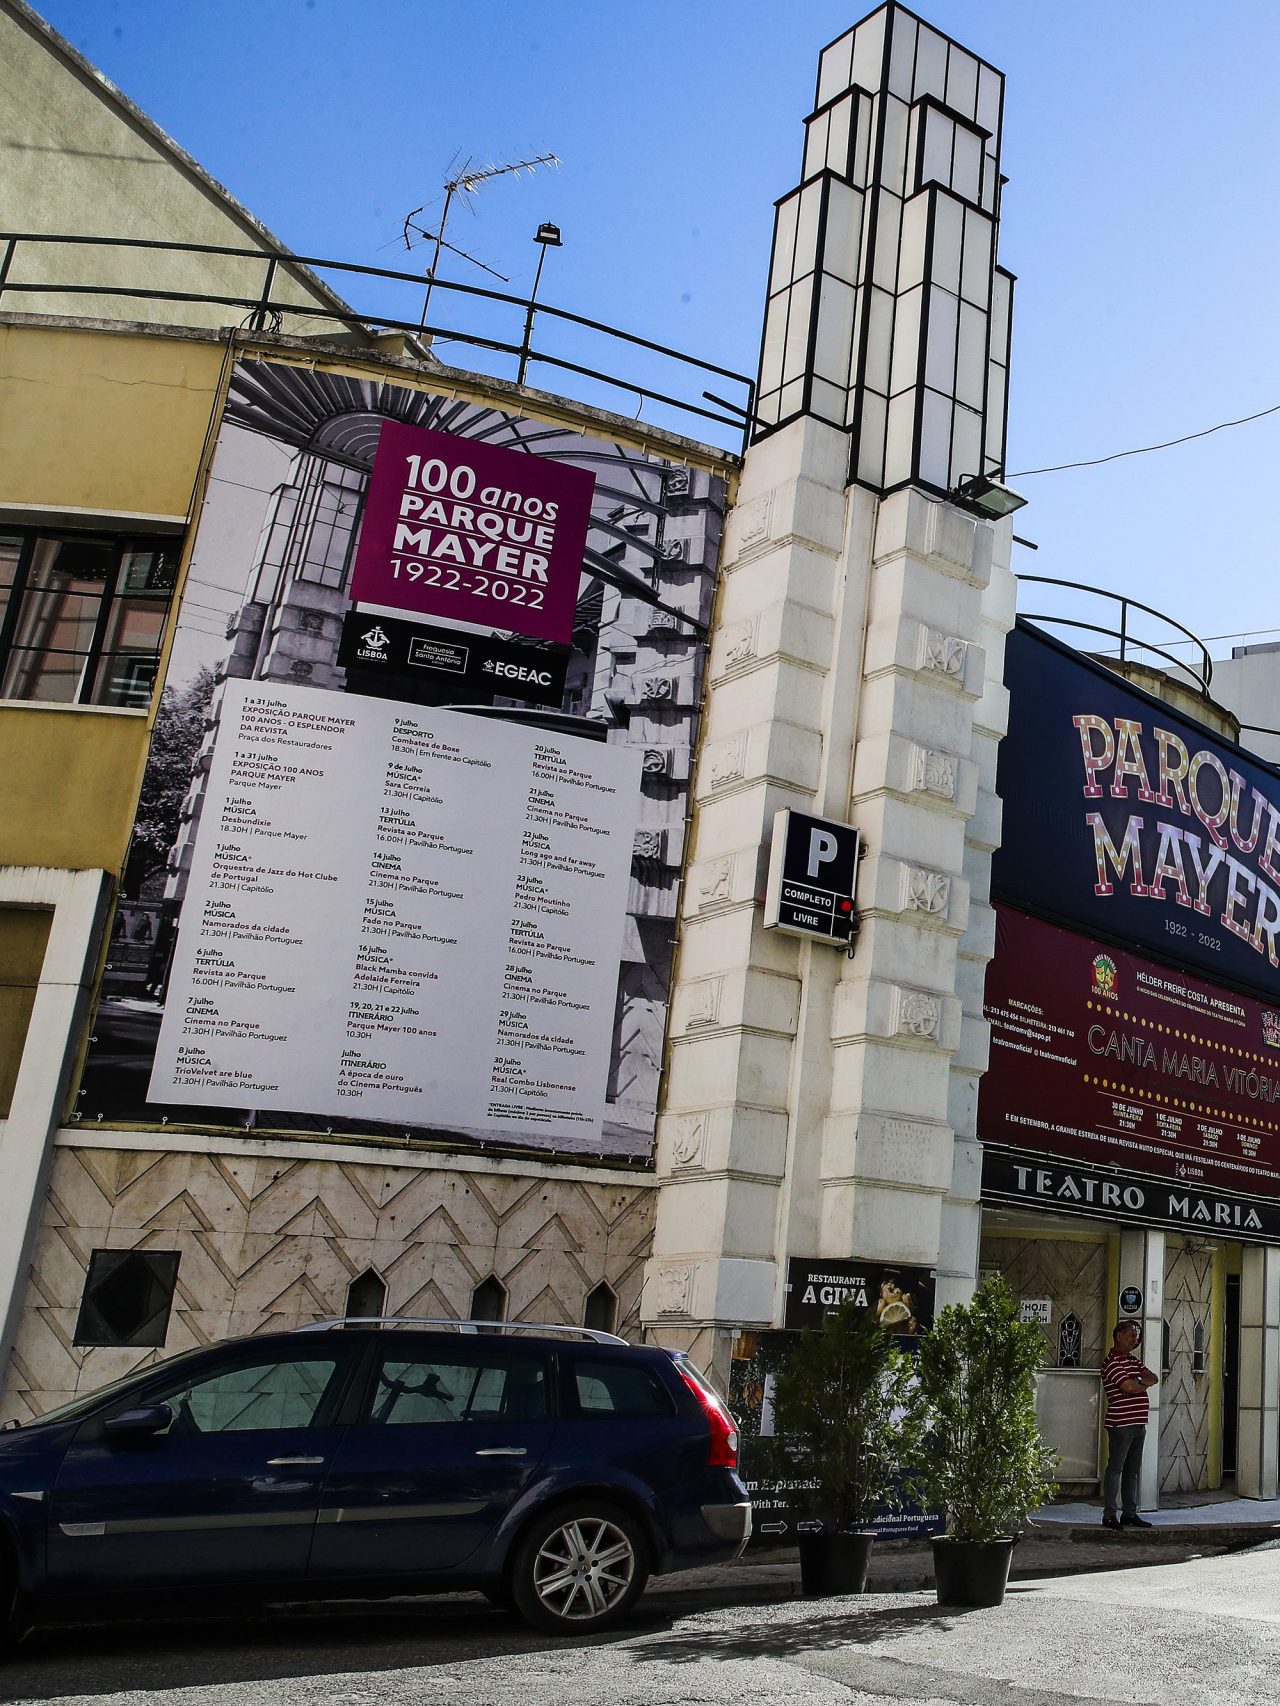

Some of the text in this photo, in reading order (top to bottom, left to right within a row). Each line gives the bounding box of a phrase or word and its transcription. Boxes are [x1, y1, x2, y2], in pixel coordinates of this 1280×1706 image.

[405, 454, 558, 521] 100 anos
[400, 494, 554, 550] PARQUE
[393, 524, 549, 583] MAYER
[390, 560, 544, 610] 1922-2022
[357, 649, 387, 660] LISBOA
[495, 662, 551, 686] EGEAC
[267, 700, 287, 708] julho
[242, 706, 355, 726] EXPOSIÇÃO PARQUE MAYER
[254, 726, 288, 735] REVISTA
[257, 717, 281, 725] ANOS
[297, 722, 345, 734] ESPLENDOR
[393, 727, 433, 739] DESPORTO
[239, 733, 259, 743] Praça
[278, 738, 332, 750] Restauradores
[392, 736, 429, 748] Combates
[442, 744, 459, 753] Boxe
[258, 754, 278, 762] julho
[231, 770, 296, 782] PARQUE MAYER
[233, 761, 281, 772] EXPOSIÇÃO
[300, 768, 324, 776] ANOS
[229, 779, 282, 791] Parque Mayer
[403, 783, 430, 793] Correia
[231, 798, 251, 806] julho
[223, 805, 257, 815] MÚSICA
[222, 816, 271, 827] Desbundixie
[521, 849, 596, 868] Long ago and far away
[807, 828, 838, 878] P
[213, 863, 338, 881] Orquestra de Jazz do Hot Clube
[223, 872, 258, 882] Portugal
[515, 893, 571, 908] Pedro Moutinho
[784, 888, 831, 906] COMPLETO
[202, 919, 249, 930] Namorados
[263, 925, 289, 933] cidade
[794, 912, 818, 926] LIVRE
[1164, 919, 1188, 938] 1922
[1198, 932, 1221, 951] 2022
[356, 964, 438, 979] Black Mamba convida
[354, 973, 420, 987] Adelaide Ferreira
[1092, 986, 1118, 1000] 100 ANOS
[1137, 972, 1245, 1017] HÉLDER FREIRE COSTA APRESENTA
[349, 1012, 393, 1022] ITINERÁRIO
[347, 1021, 437, 1037] Parque Mayer 100 anos
[1088, 1025, 1157, 1070] CANTA
[1162, 1048, 1219, 1088] MARIA
[492, 1076, 576, 1091] Real Combo Lisbonense
[1020, 1117, 1050, 1130] SETEMBRO,
[1056, 1126, 1077, 1135] GRANDE
[1078, 1130, 1099, 1140] ESTREIA
[1100, 1134, 1106, 1142] DE
[1119, 1138, 1138, 1149] REVISTA
[1013, 1165, 1145, 1209] TEATRO
[1169, 1194, 1262, 1229] MARIA
[808, 1274, 865, 1285] RESTAURANTE
[802, 1285, 816, 1303] A
